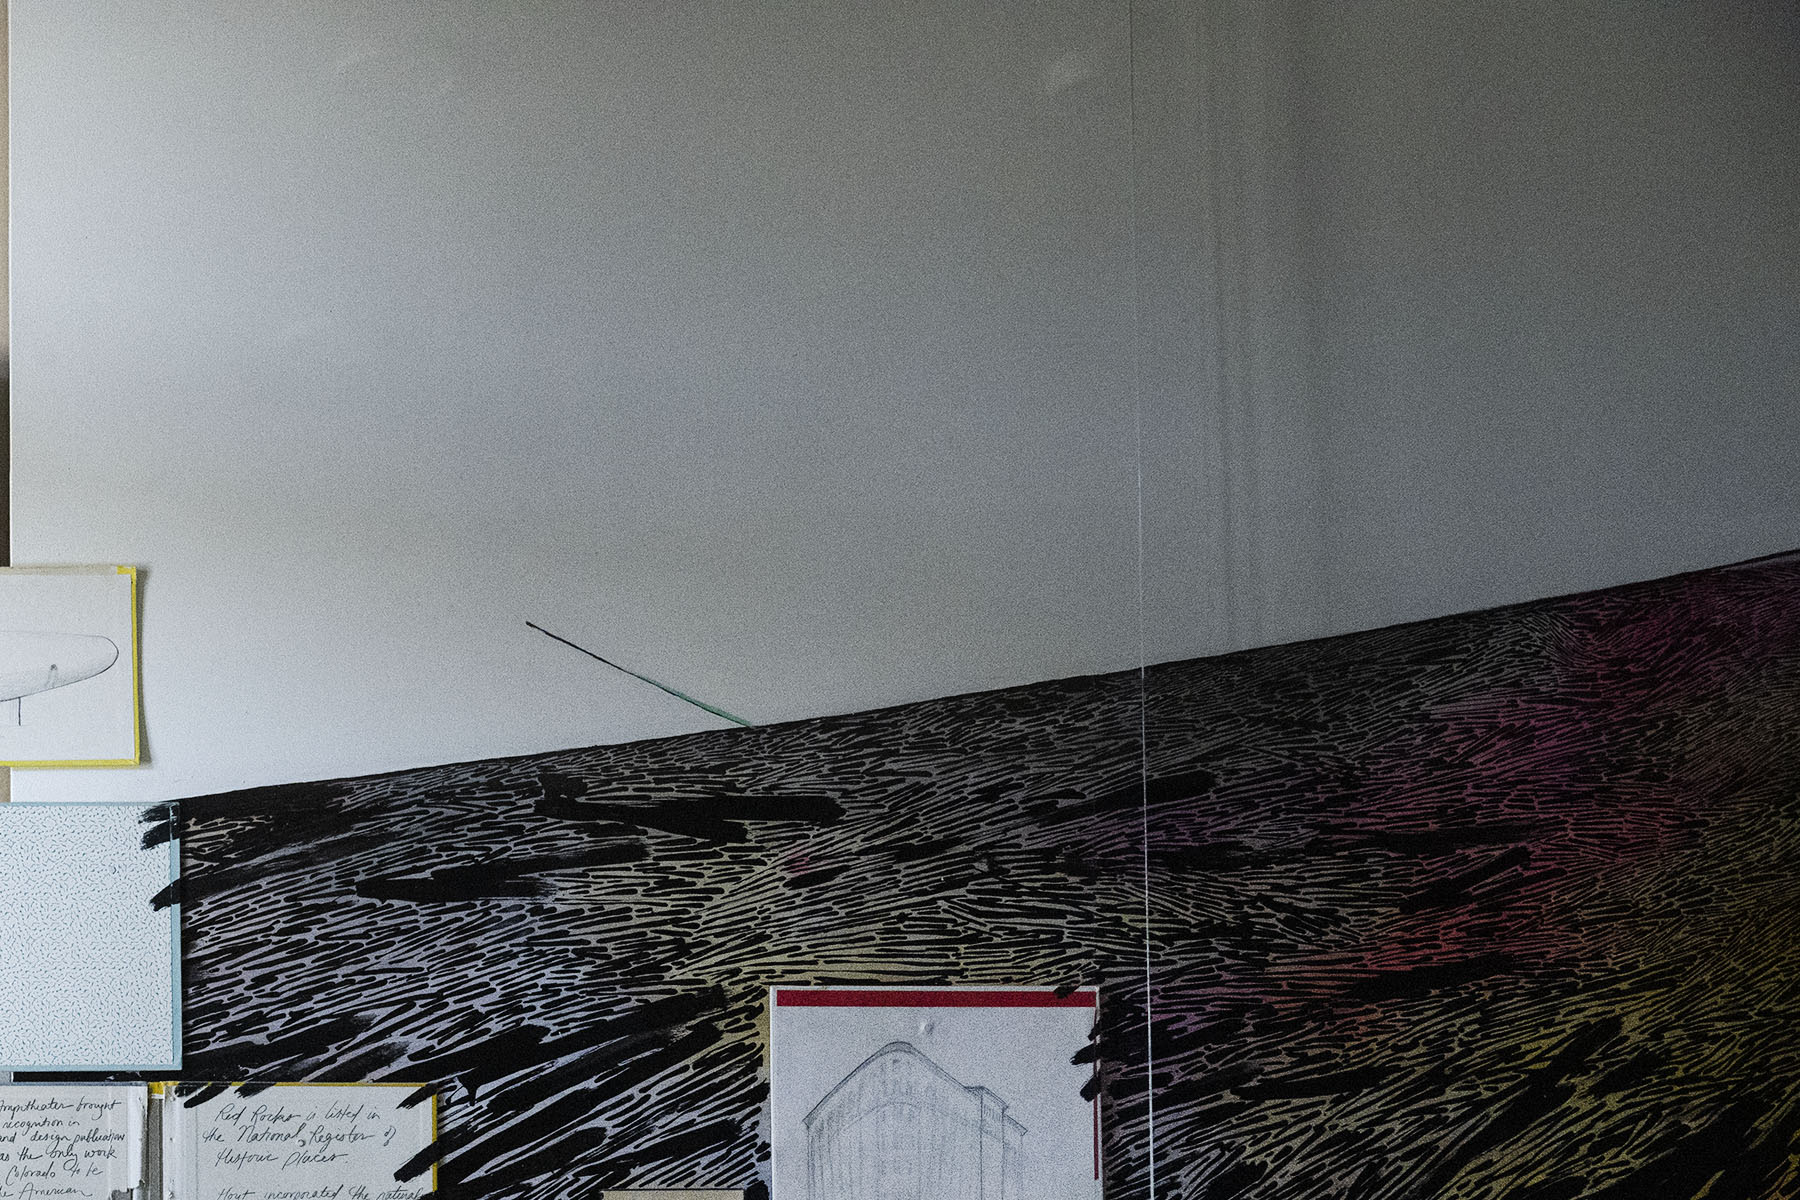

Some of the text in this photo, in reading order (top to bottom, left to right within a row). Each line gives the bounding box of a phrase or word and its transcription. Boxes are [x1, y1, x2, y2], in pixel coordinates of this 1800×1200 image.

[215, 1103, 245, 1122] Red
[250, 1105, 301, 1123] Rocks
[84, 1148, 118, 1159] work
[5, 1168, 56, 1186] Colorado
